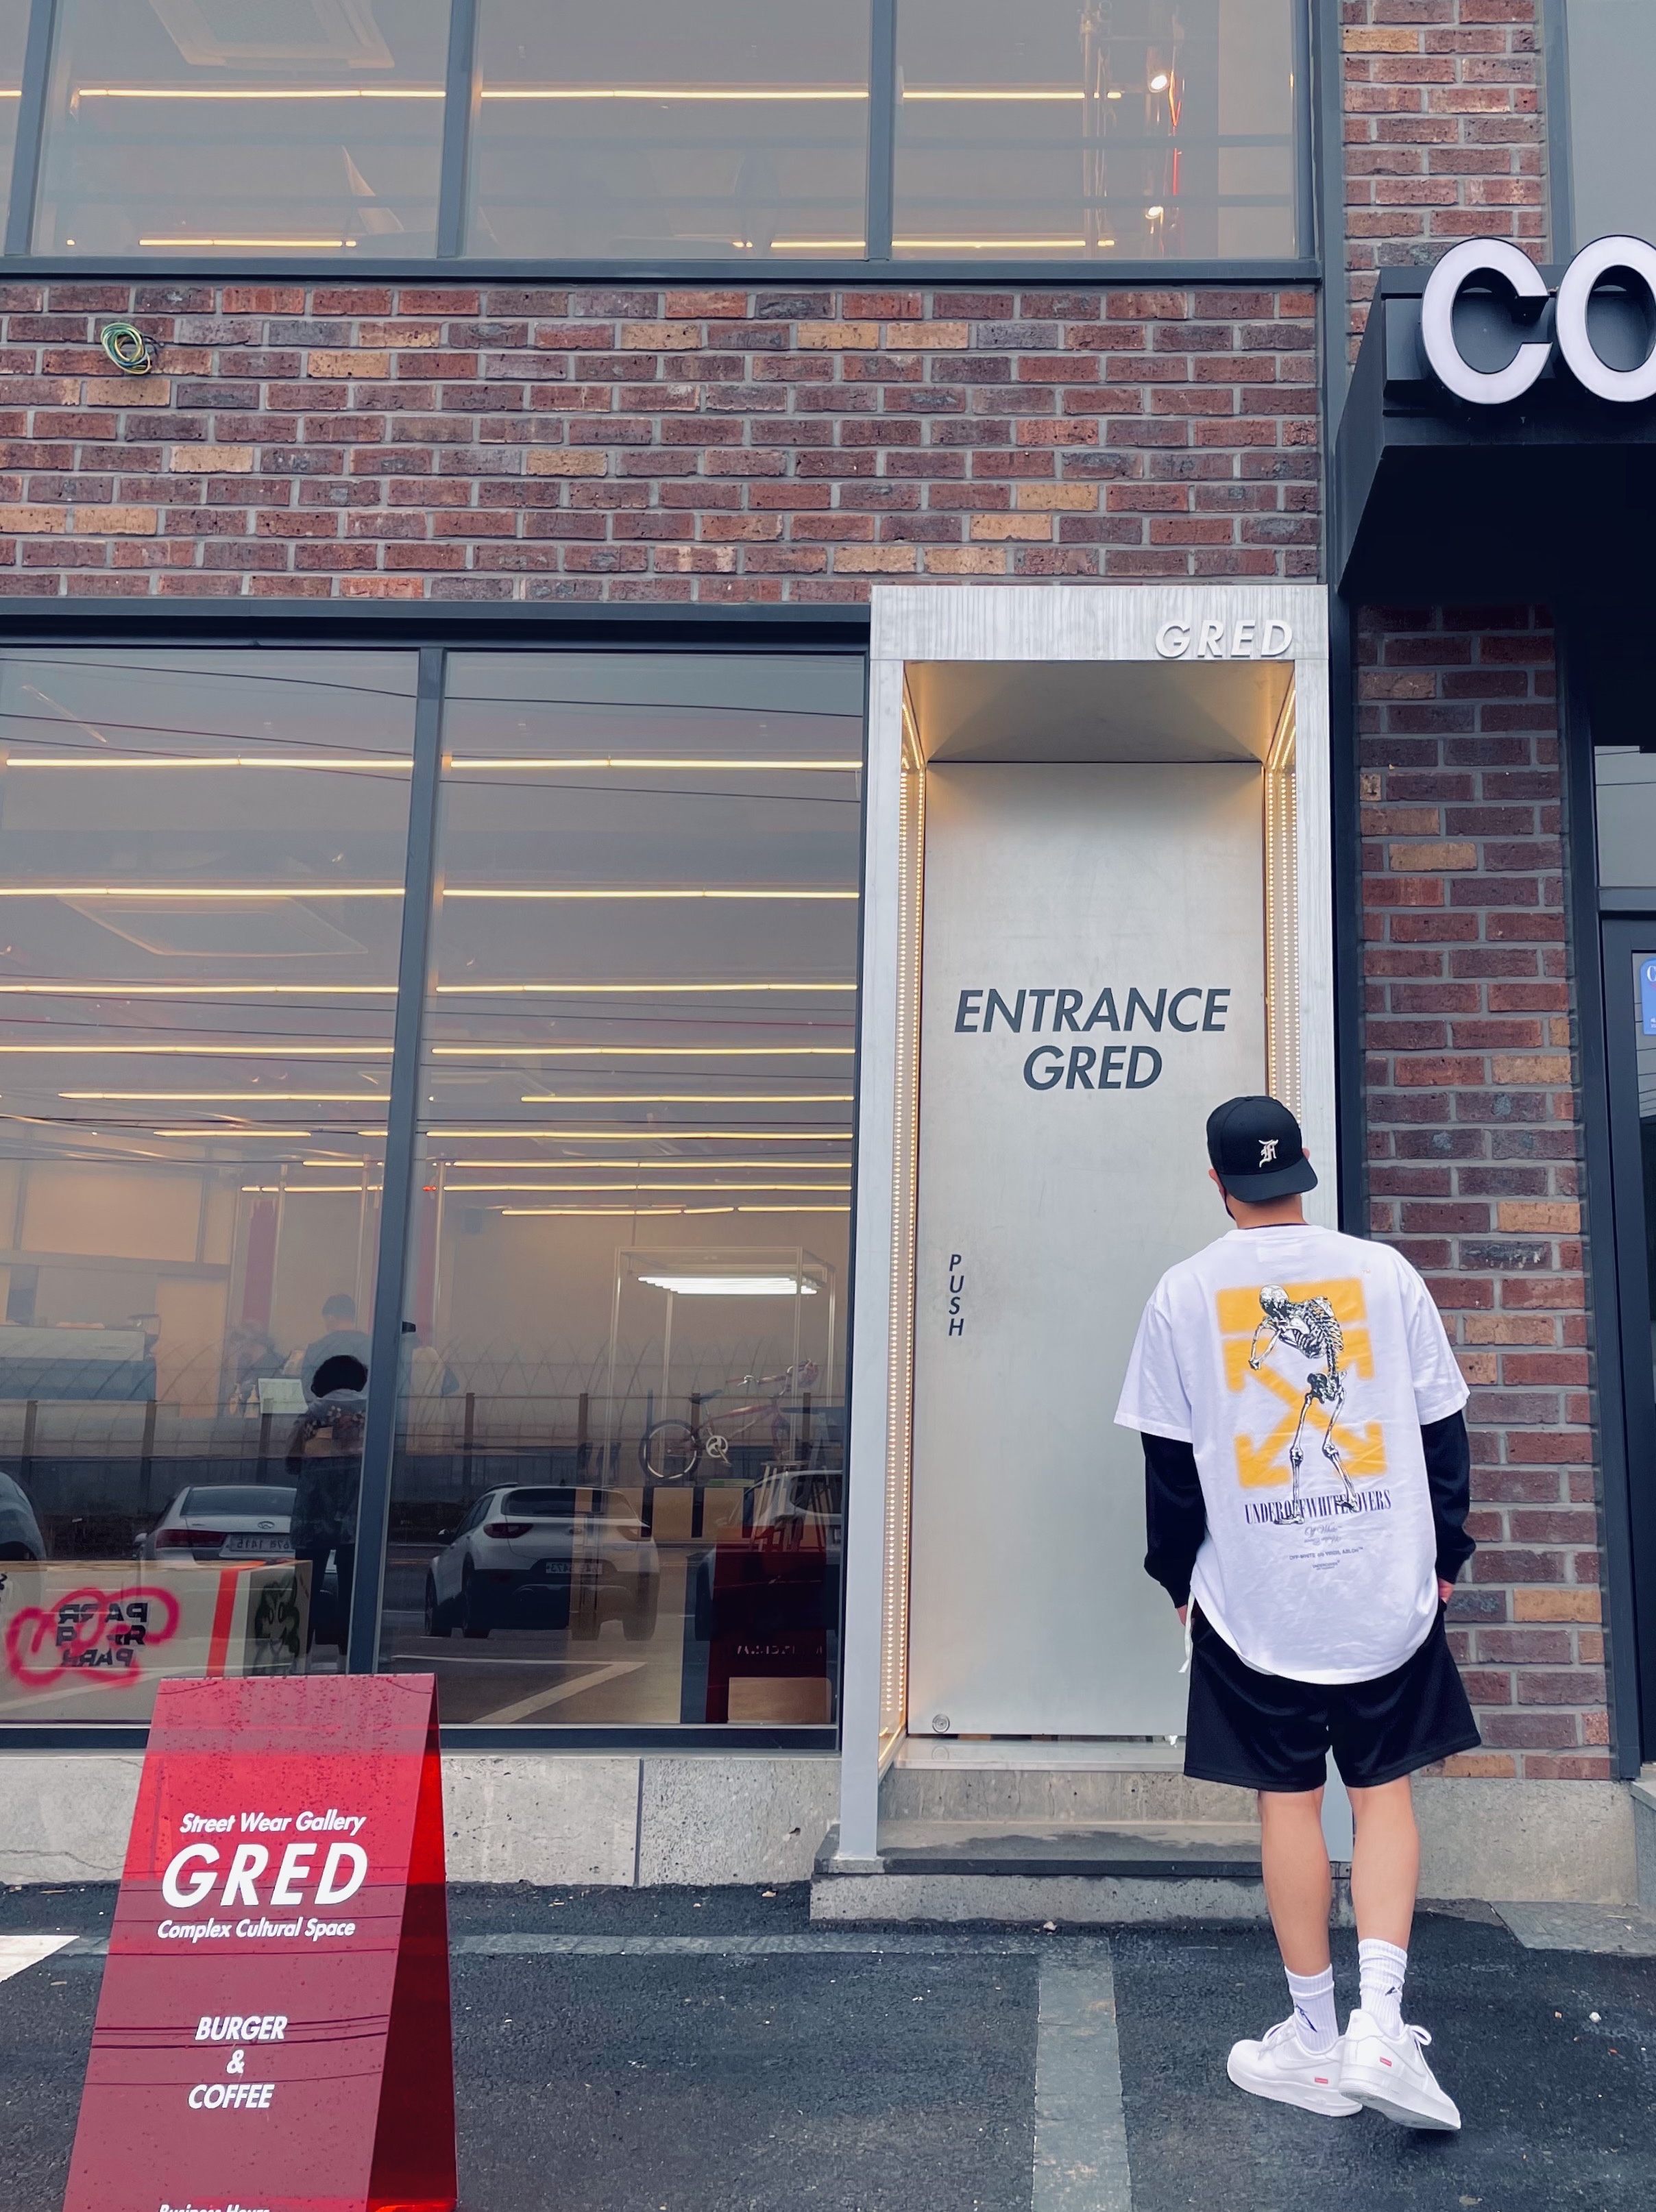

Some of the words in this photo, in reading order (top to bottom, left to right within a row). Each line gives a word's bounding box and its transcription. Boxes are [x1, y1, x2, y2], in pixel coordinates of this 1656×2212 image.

[1421, 234, 1656, 404] CO
[1155, 619, 1293, 658] GRED
[955, 987, 1231, 1033] ENTRANCE
[1023, 1044, 1162, 1090] GRED
[949, 1254, 964, 1337] PUSH
[180, 1812, 235, 1833] Street
[241, 1812, 292, 1832] Wear
[295, 1808, 367, 1836] Gallery
[162, 1843, 368, 1908] GRED
[157, 1917, 232, 1943] Complex
[236, 1917, 304, 1938] Cultural
[304, 1918, 356, 1942] Space
[195, 2016, 288, 2041] BURGER
[226, 2050, 245, 2074] &
[188, 2084, 276, 2110] COFFEE
